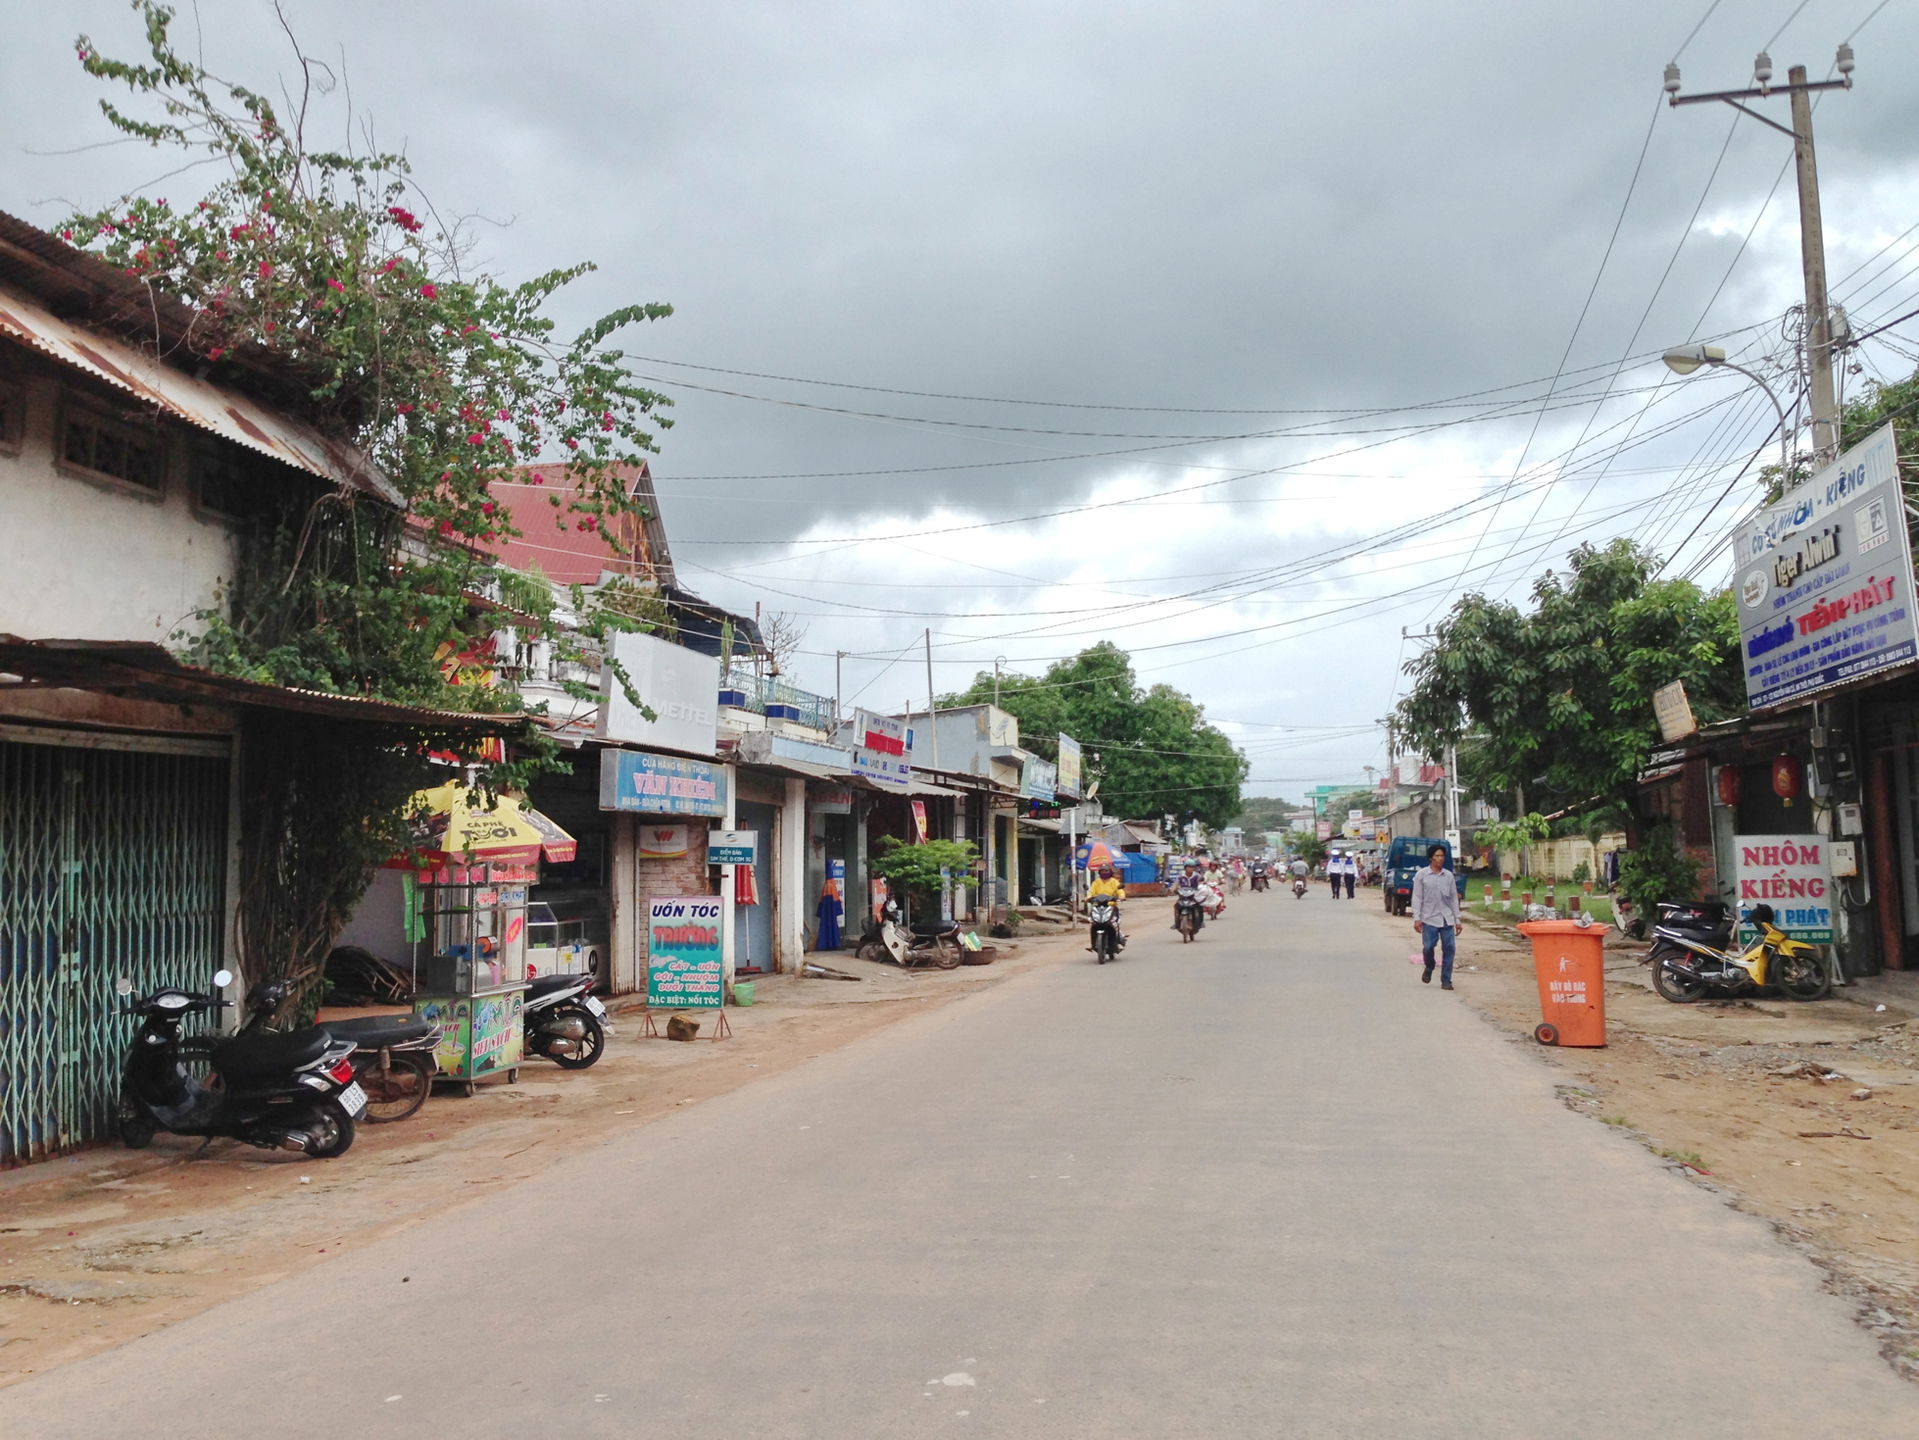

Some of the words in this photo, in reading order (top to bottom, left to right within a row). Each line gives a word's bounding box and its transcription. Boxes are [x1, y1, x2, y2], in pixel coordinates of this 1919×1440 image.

[1770, 552, 1801, 588] Tiger
[1838, 575, 1896, 623] PHÁT
[633, 770, 667, 796] VĂN
[1742, 839, 1820, 867] NHÔM
[1740, 868, 1825, 899] KIẾNG
[652, 900, 685, 918] UỐN
[691, 902, 719, 918] TÓC
[1785, 905, 1830, 926] PHÁT
[653, 920, 720, 951] TRƯỜNG
[669, 959, 690, 971] CẮT
[698, 960, 721, 971] UỐN
[649, 995, 666, 1005] ĐẶC
[666, 994, 687, 1005] BIỆT:
[688, 993, 702, 1004] NỐI
[703, 994, 720, 1005] TÓC
